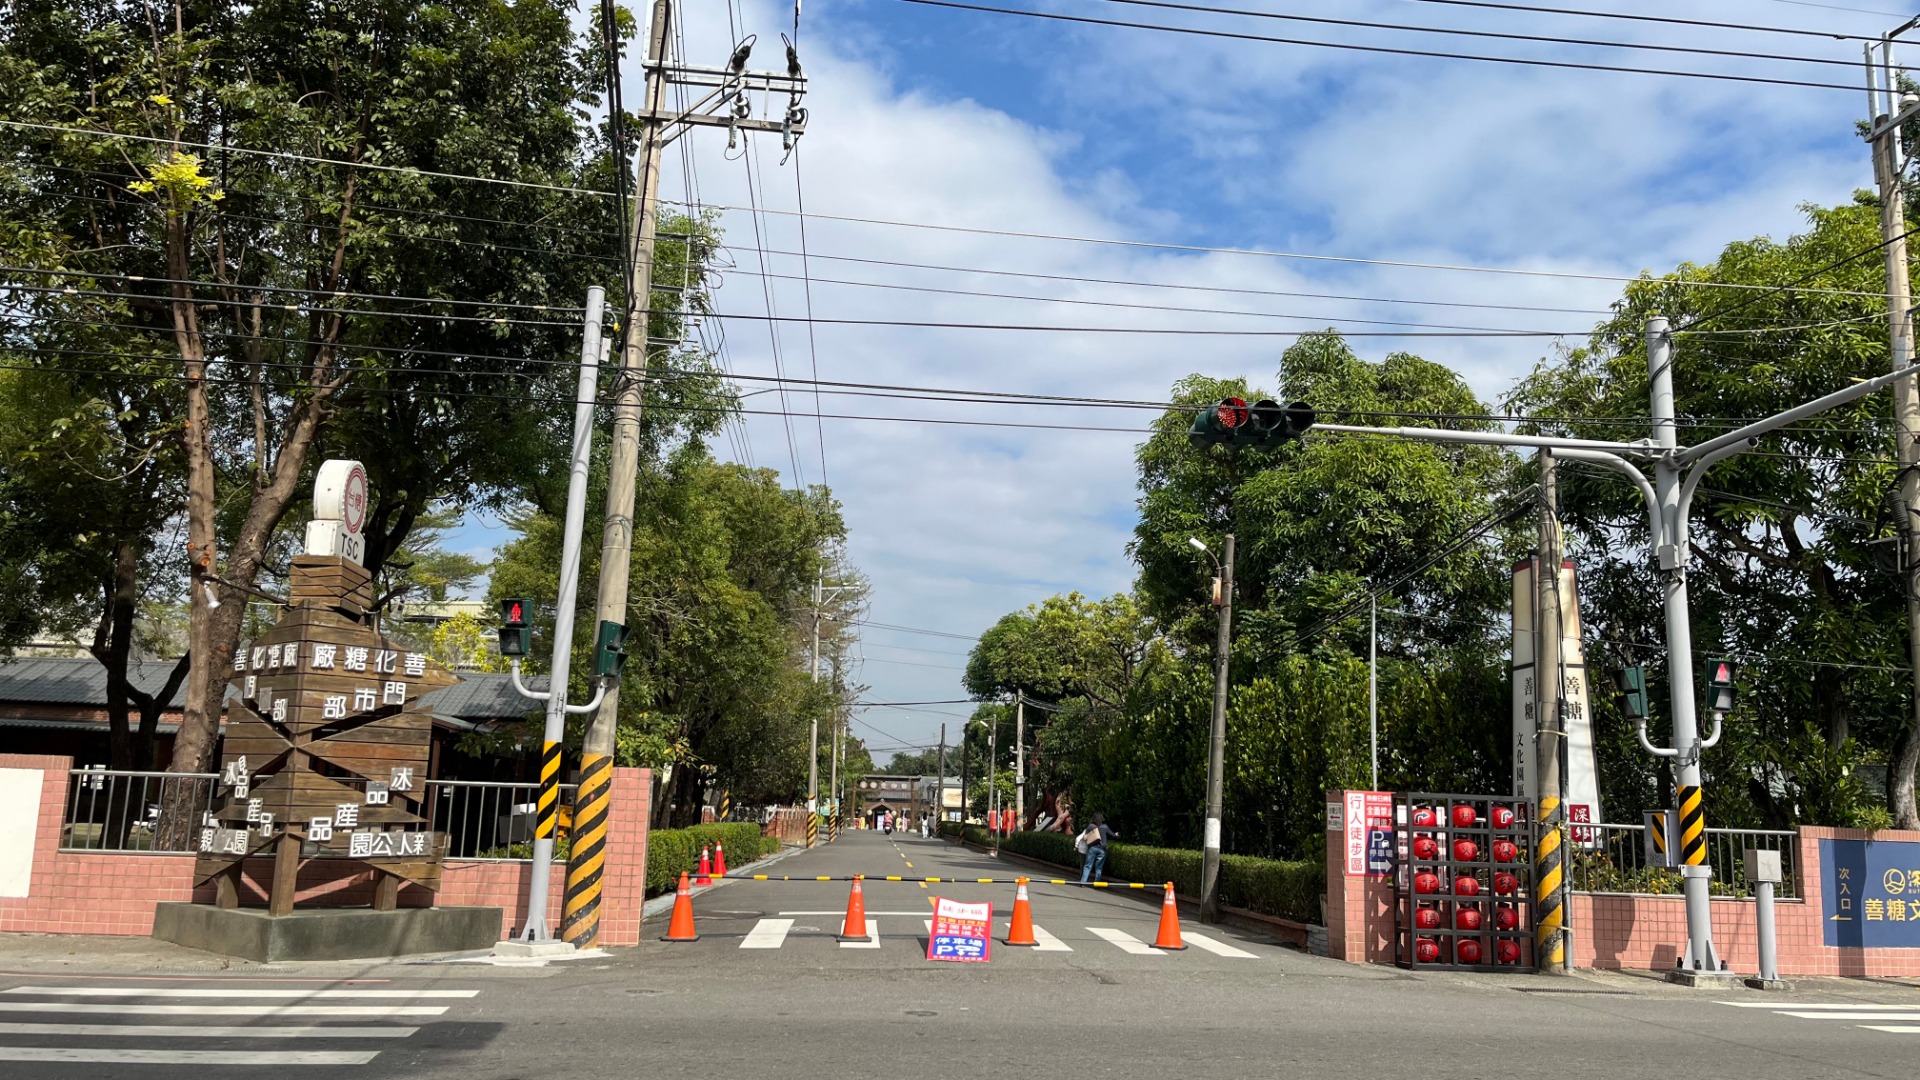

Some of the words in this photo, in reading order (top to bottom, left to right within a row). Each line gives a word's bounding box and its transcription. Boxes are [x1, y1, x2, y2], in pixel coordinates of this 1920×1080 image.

[341, 532, 359, 560] TSC
[1524, 676, 1534, 721] 善糖
[1516, 731, 1524, 798] 文化園區
[1350, 795, 1363, 872] 行人徒步區
[1371, 830, 1385, 848] P
[1838, 867, 1851, 910] 次入口
[935, 936, 983, 948] 停車場
[936, 945, 954, 955] P
